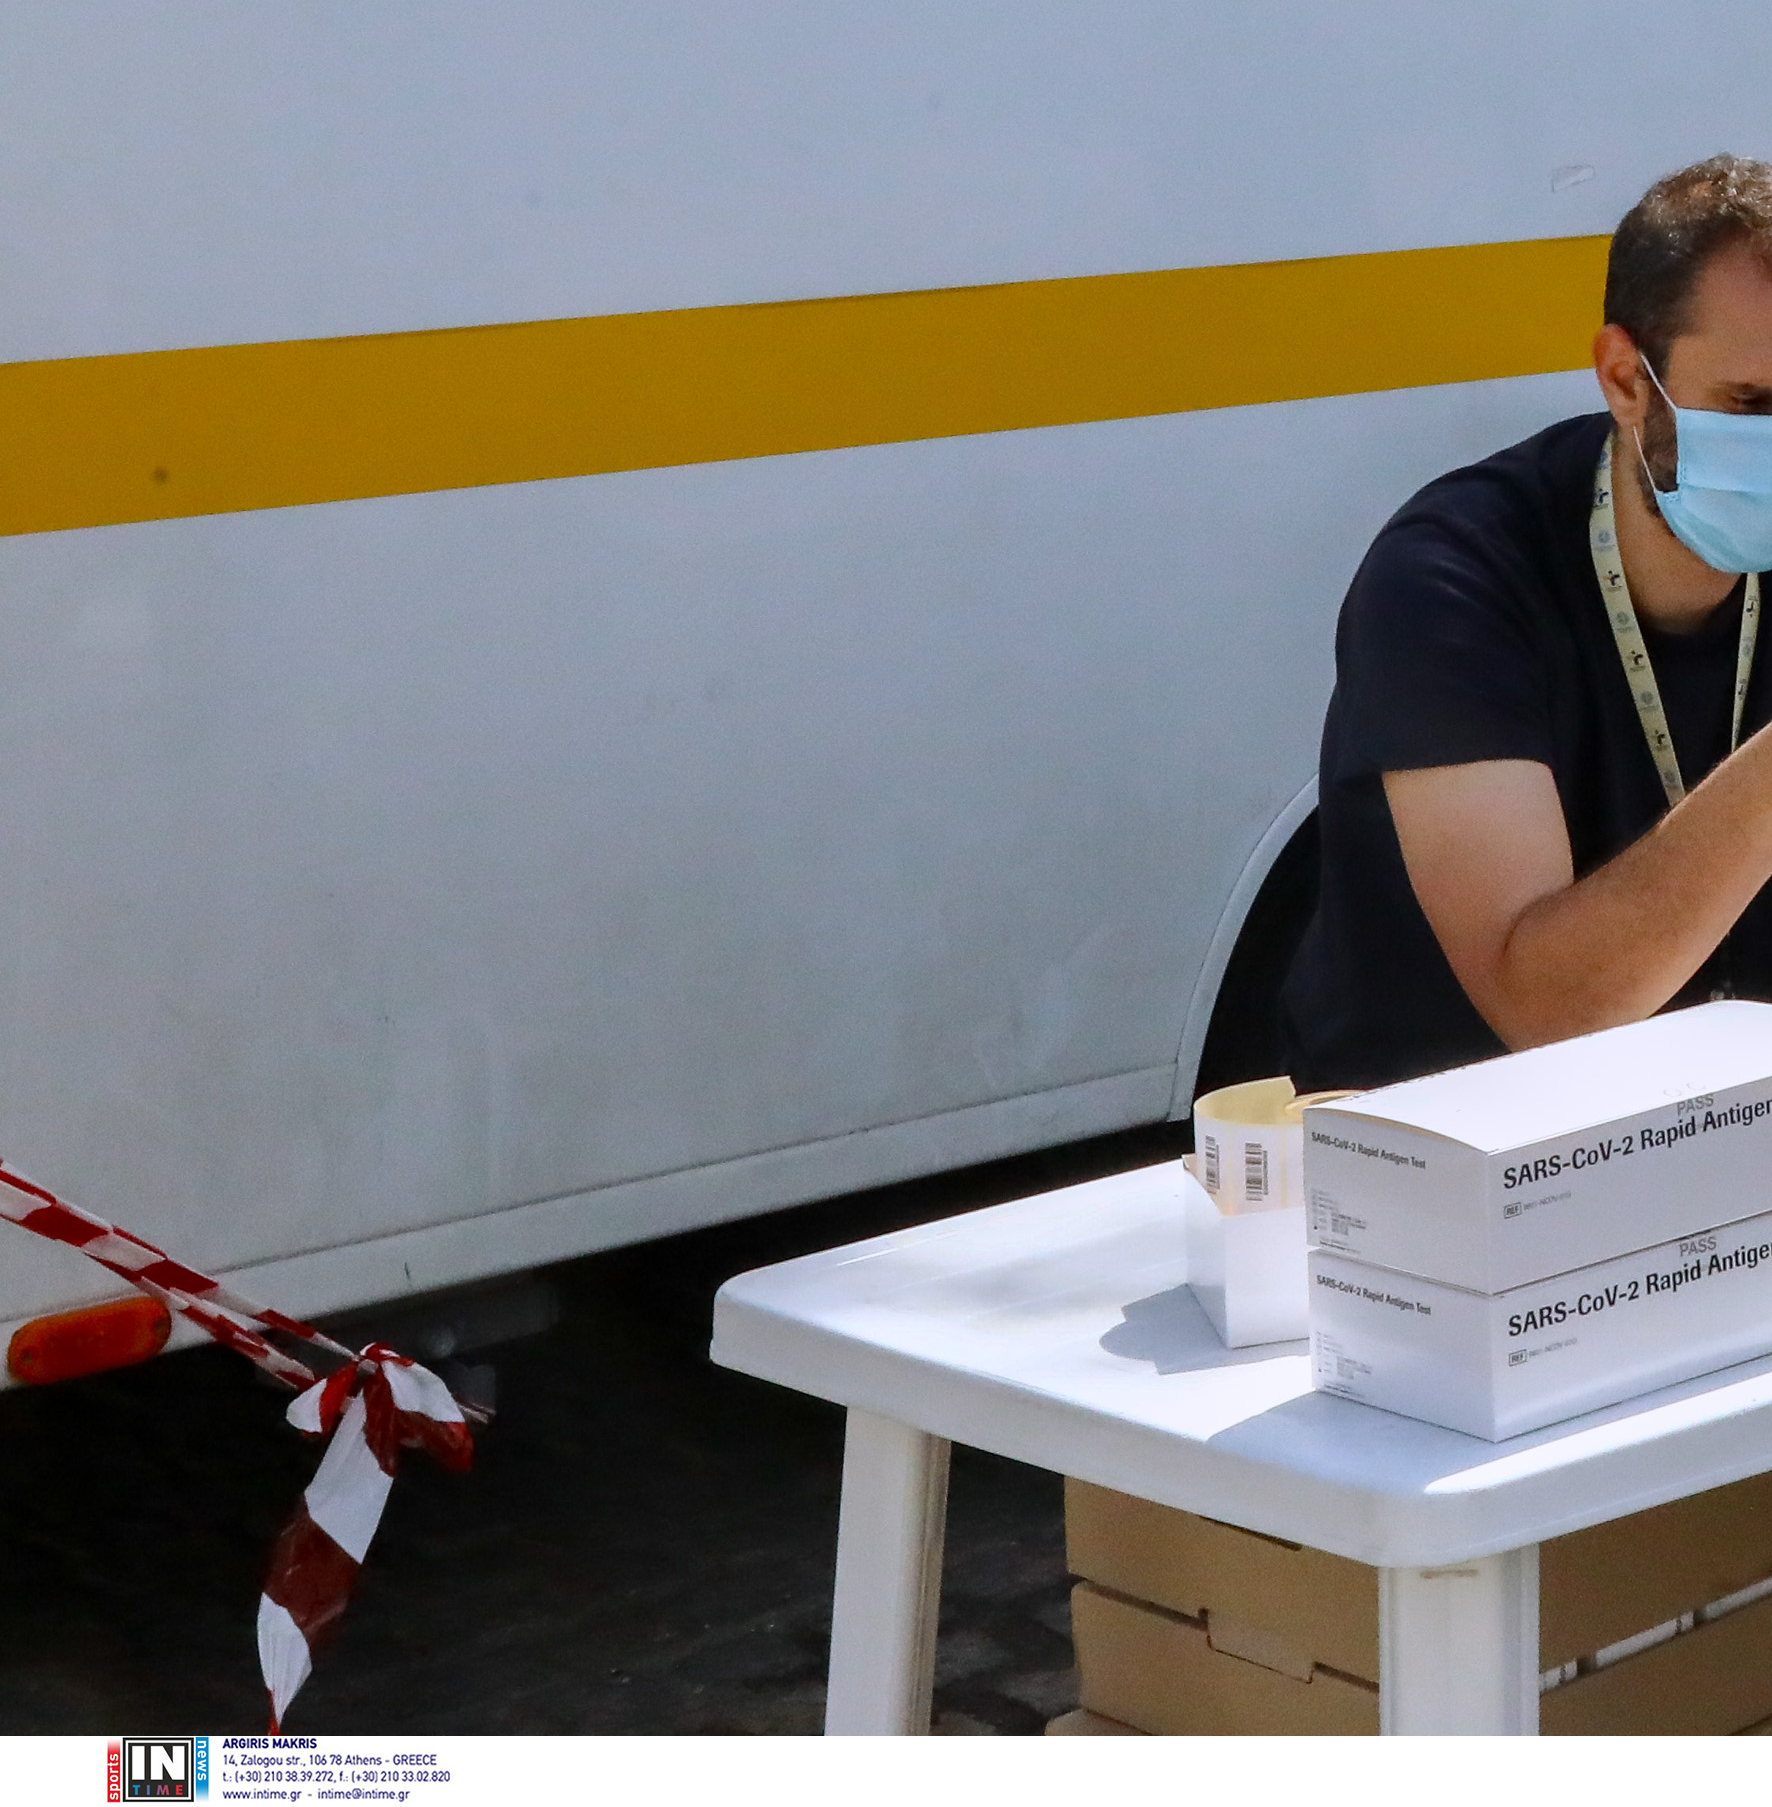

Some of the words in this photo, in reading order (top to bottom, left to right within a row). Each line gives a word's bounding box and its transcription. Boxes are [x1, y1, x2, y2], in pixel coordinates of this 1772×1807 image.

[1677, 1094, 1714, 1116] PASS
[1311, 1132, 1356, 1153] SARS-CoV-2
[1358, 1144, 1379, 1158] Rapid
[1380, 1150, 1409, 1166] Antigen
[1411, 1156, 1426, 1169] Test
[1504, 1136, 1634, 1189] SARS-CoV-2
[1641, 1115, 1696, 1150] Rapid
[1679, 1236, 1717, 1257] PASS
[1317, 1275, 1361, 1296] SARS-CoV-2
[1363, 1288, 1384, 1303] Rapid
[1386, 1295, 1414, 1311] Antigen
[1416, 1302, 1431, 1315] Test
[1508, 1281, 1639, 1337] SARS-CoV-2
[1646, 1259, 1701, 1294] Rapid
